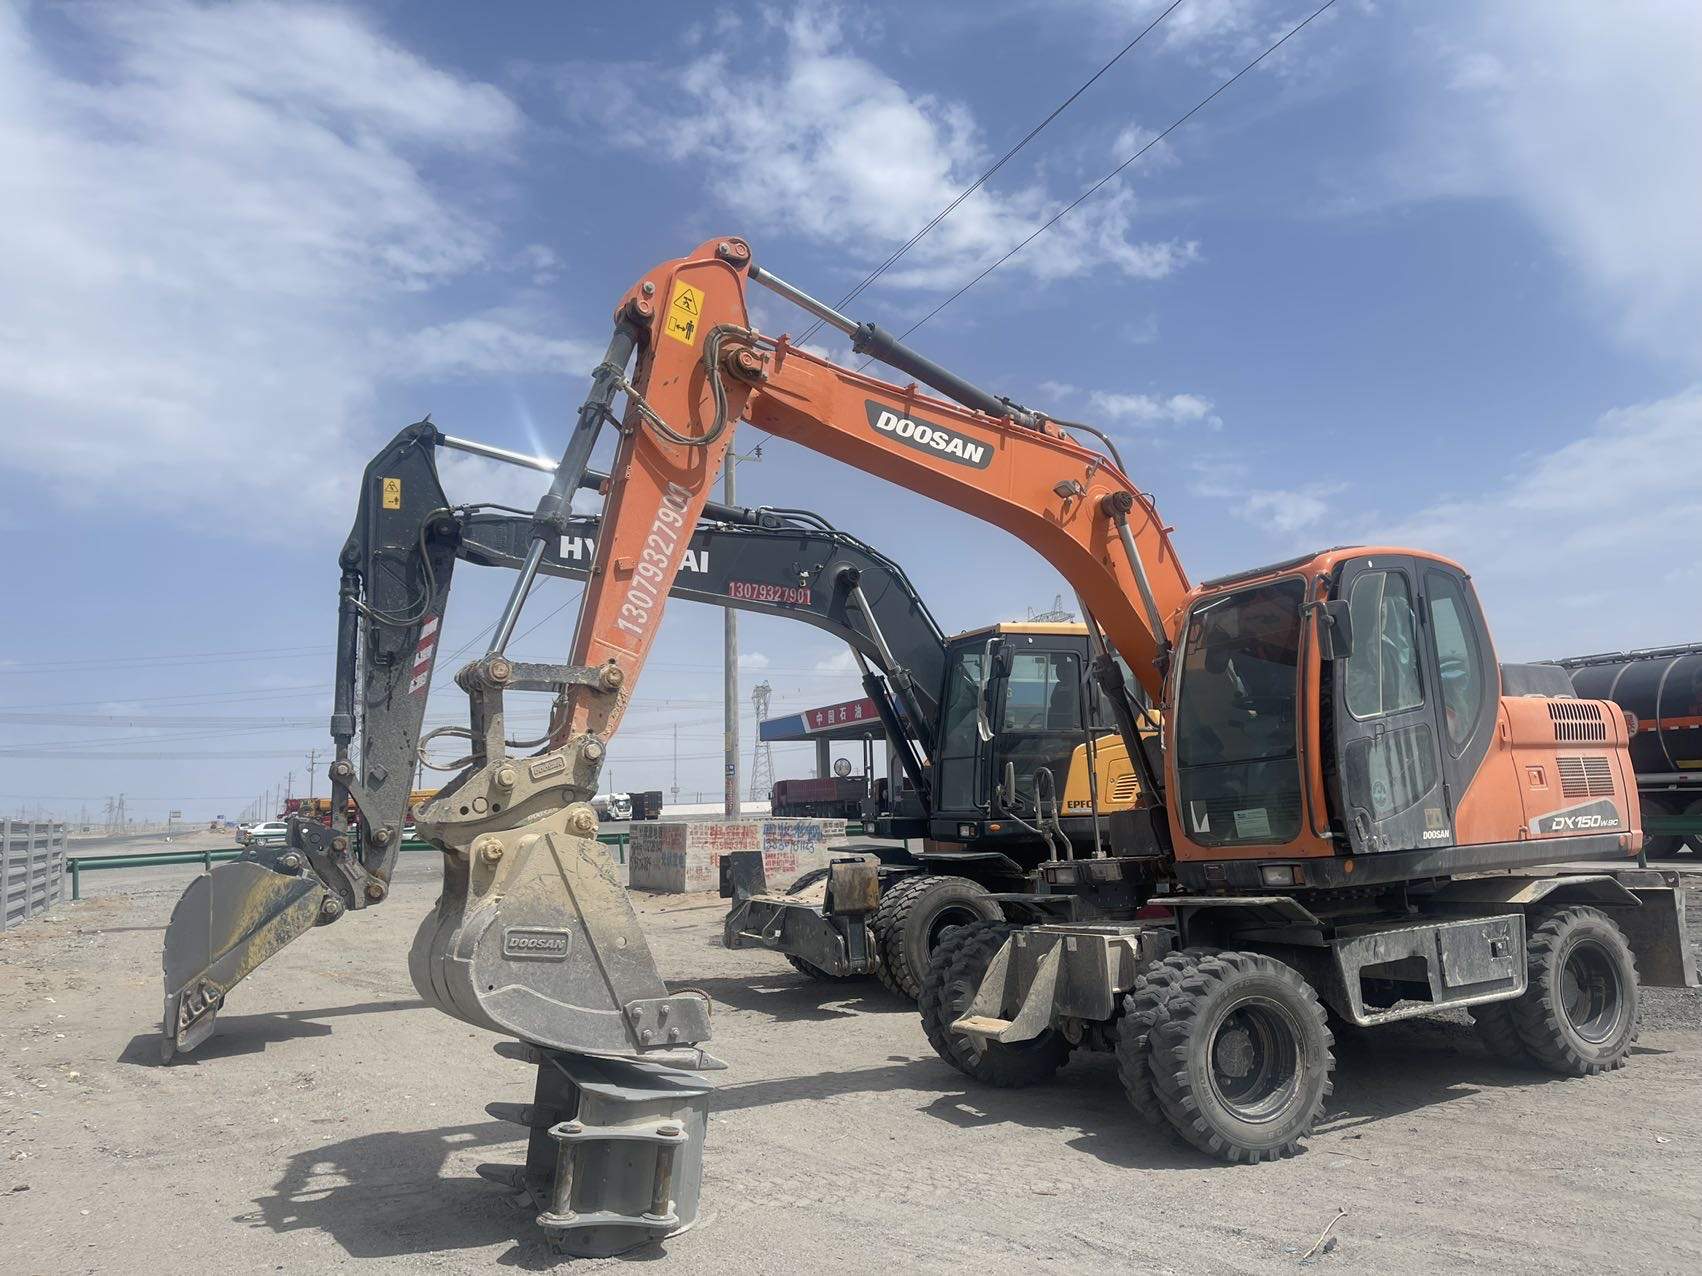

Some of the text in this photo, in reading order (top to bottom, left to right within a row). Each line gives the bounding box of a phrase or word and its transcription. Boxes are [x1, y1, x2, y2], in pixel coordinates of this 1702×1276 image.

[876, 411, 984, 463] DOOSAN
[617, 480, 693, 634] 13079327901
[729, 582, 811, 605] 13079327901
[816, 704, 862, 725] 中国石油
[1423, 829, 1450, 840] DOOSAN
[508, 937, 565, 949] DOOSAN
